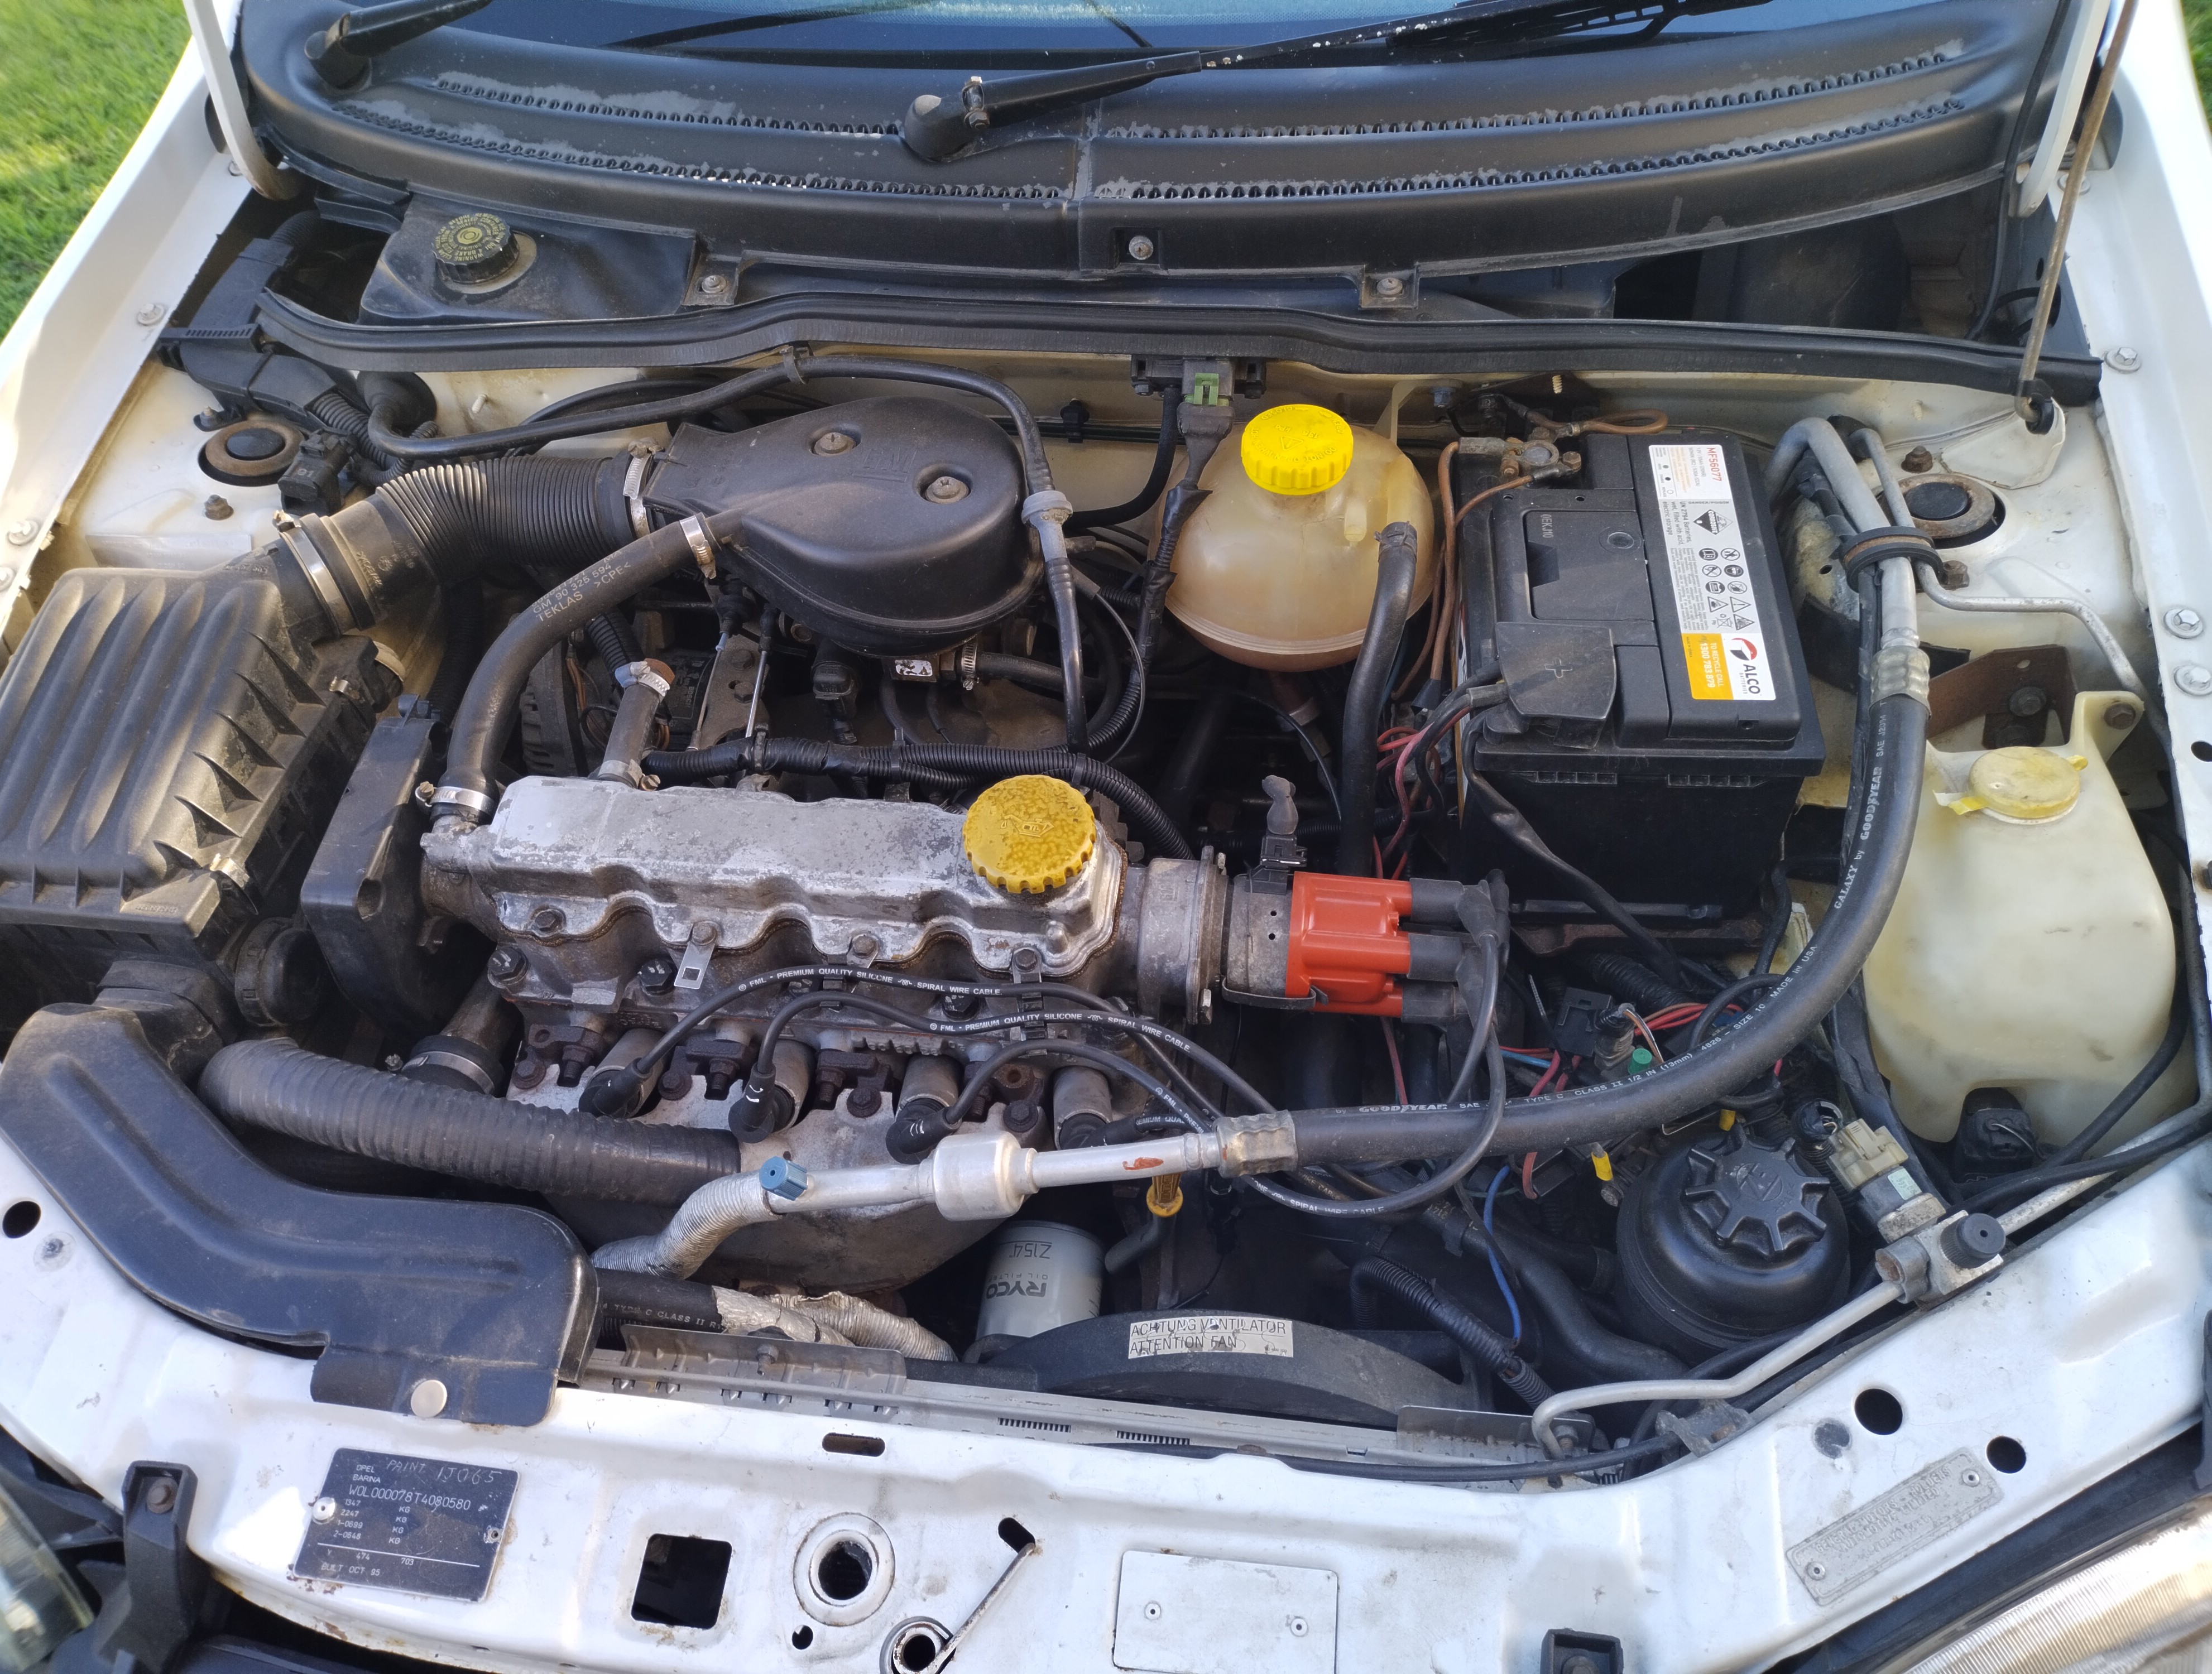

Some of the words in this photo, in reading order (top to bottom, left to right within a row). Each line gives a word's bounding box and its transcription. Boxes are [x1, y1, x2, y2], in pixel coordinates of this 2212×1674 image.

[1261, 406, 1293, 420] CLOSED
[1325, 446, 1337, 455] DO
[1274, 454, 1300, 463] OPEN
[1707, 447, 1722, 482] MF56077
[1708, 511, 1718, 533] CORROSIVE
[533, 599, 552, 614] GM
[555, 589, 569, 600] 90
[570, 576, 590, 591] 325
[592, 563, 611, 578] 594
[538, 591, 583, 622] TEKLAS
[1700, 642, 1710, 659] 1300
[1704, 660, 1712, 674] 783
[1712, 650, 1722, 675] RECYCLE
[1706, 675, 1715, 688] 879
[1739, 672, 1748, 694] BATTERIES
[1743, 664, 1760, 694] ALCO
[1023, 824, 1039, 832] OIL
[1359, 1104, 1447, 1113] GOODYEAR
[1525, 1094, 1552, 1103] TYPE
[1574, 1084, 1608, 1096] CLASS
[1628, 1074, 1642, 1084] 1/2
[1660, 1053, 1693, 1071] (13mm)
[1733, 1013, 1754, 1030] SIZE
[1755, 1004, 1766, 1013] 10
[1769, 977, 1793, 998] MADE
[1792, 965, 1803, 975] IN
[1801, 945, 1817, 964] USA
[1834, 865, 1858, 910] GALAXY
[1854, 850, 1865, 860] by
[1860, 767, 1882, 840] GOODYEAR
[1876, 740, 1885, 757] SAE
[750, 976, 767, 988] FML
[777, 968, 814, 979] PREMIUM
[818, 968, 853, 977] QUALITY
[857, 971, 893, 984] SILICONE
[917, 983, 946, 993] SPIRAL
[950, 986, 970, 995] WIRE
[965, 1019, 1000, 1031] PREMIUM
[1004, 1014, 1040, 1023] QUALITY
[1044, 1012, 1083, 1021] SILICONE
[1107, 1016, 1138, 1030] SPIRAL
[1141, 1025, 1162, 1038] WIRE
[1164, 1094, 1176, 1108] FML
[1290, 1199, 1318, 1213] SPIRAL
[986, 1281, 1047, 1299] RYCO
[658, 1310, 690, 1323] CLASS
[1131, 1319, 1196, 1336] ACHTUNG
[1200, 1319, 1286, 1334] VENTILATOR
[1130, 1336, 1204, 1354] ATTENTION
[1210, 1336, 1237, 1348] FAN
[356, 1464, 375, 1473] OPEL
[387, 1459, 426, 1472] PAINT
[353, 1474, 381, 1483] BARINA
[338, 1520, 363, 1529] 1-0699
[333, 1530, 361, 1540] 2-0648
[322, 1563, 342, 1572] BUILT
